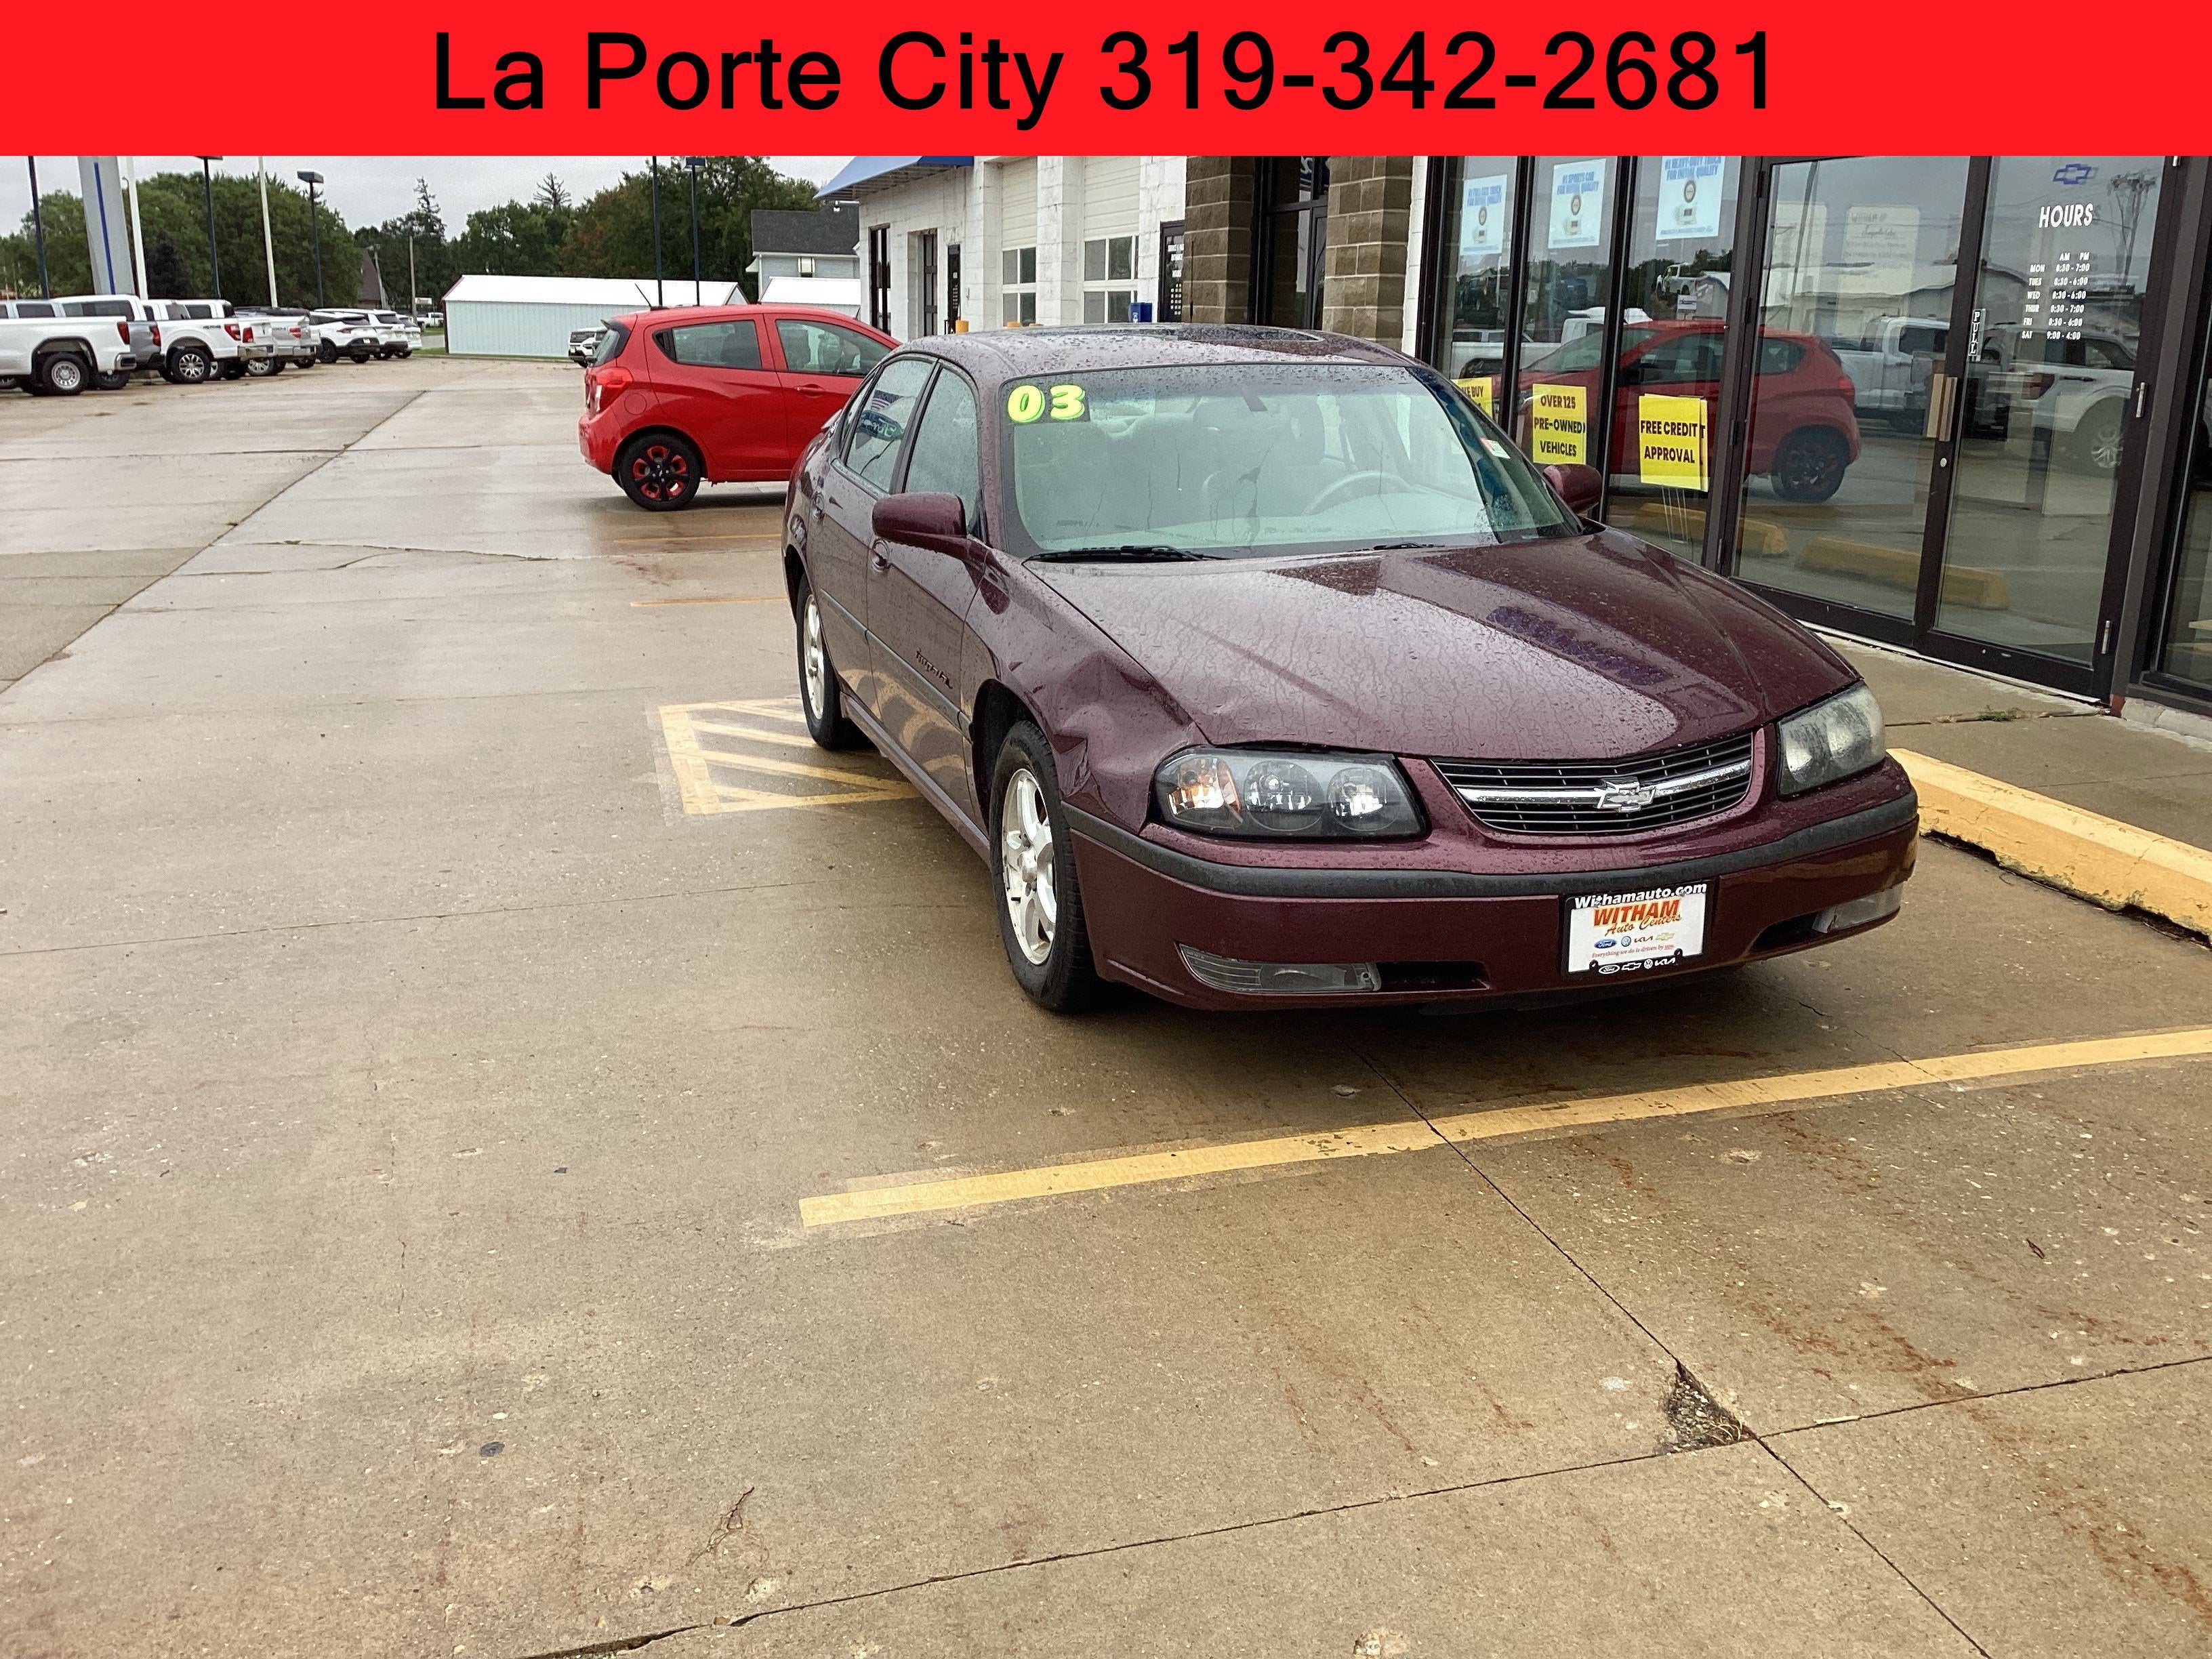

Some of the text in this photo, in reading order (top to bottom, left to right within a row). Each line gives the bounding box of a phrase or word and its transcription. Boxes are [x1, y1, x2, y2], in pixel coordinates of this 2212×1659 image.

[2039, 203, 2093, 228] HOURS
[2060, 251, 2089, 261] AM PM
[2030, 264, 2045, 272] MON
[2075, 263, 2090, 272] 7:00
[2028, 277, 2042, 286] TUES
[2072, 276, 2088, 286] 6:00
[2027, 291, 2041, 300] WED
[2071, 290, 2087, 300] 6:00
[2070, 304, 2085, 313] 7:00
[2023, 317, 2032, 326] FRI
[1969, 311, 1980, 354] PULL
[2022, 330, 2033, 339] SAT
[1471, 386, 1483, 397] BUY
[1007, 384, 1086, 423] 03
[1540, 394, 1576, 409] OVER 125
[1534, 416, 1583, 434] PRE-OWNED
[1640, 419, 1662, 435] FREE
[1663, 421, 1698, 437] CREDIT
[1540, 440, 1577, 457] VEHICLES
[1644, 445, 1696, 464] APPROVAL
[1574, 883, 1707, 909] Withamauto.com
[1594, 899, 1680, 926] WITHAM
[1605, 914, 1681, 937] Auto Centers
[1592, 950, 1619, 958] Everything
